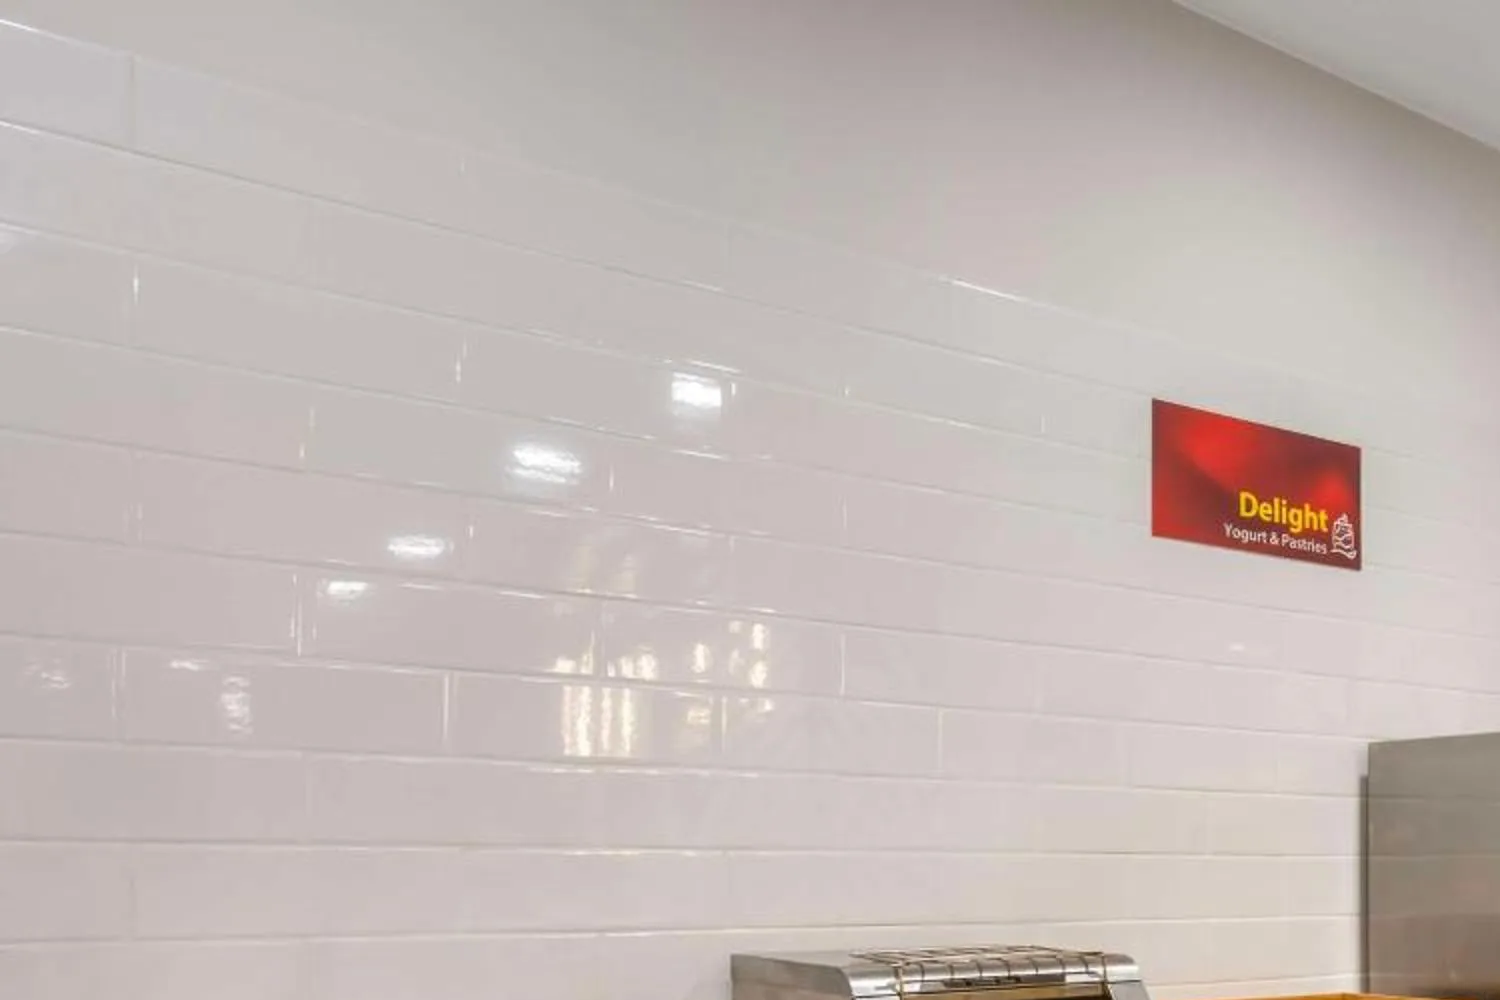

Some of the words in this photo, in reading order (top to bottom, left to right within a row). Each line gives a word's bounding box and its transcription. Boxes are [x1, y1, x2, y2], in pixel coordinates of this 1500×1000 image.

[1238, 490, 1329, 533] Delight
[1222, 522, 1268, 546] Yogurt
[1270, 532, 1280, 546] &
[1281, 533, 1328, 555] Pastries
